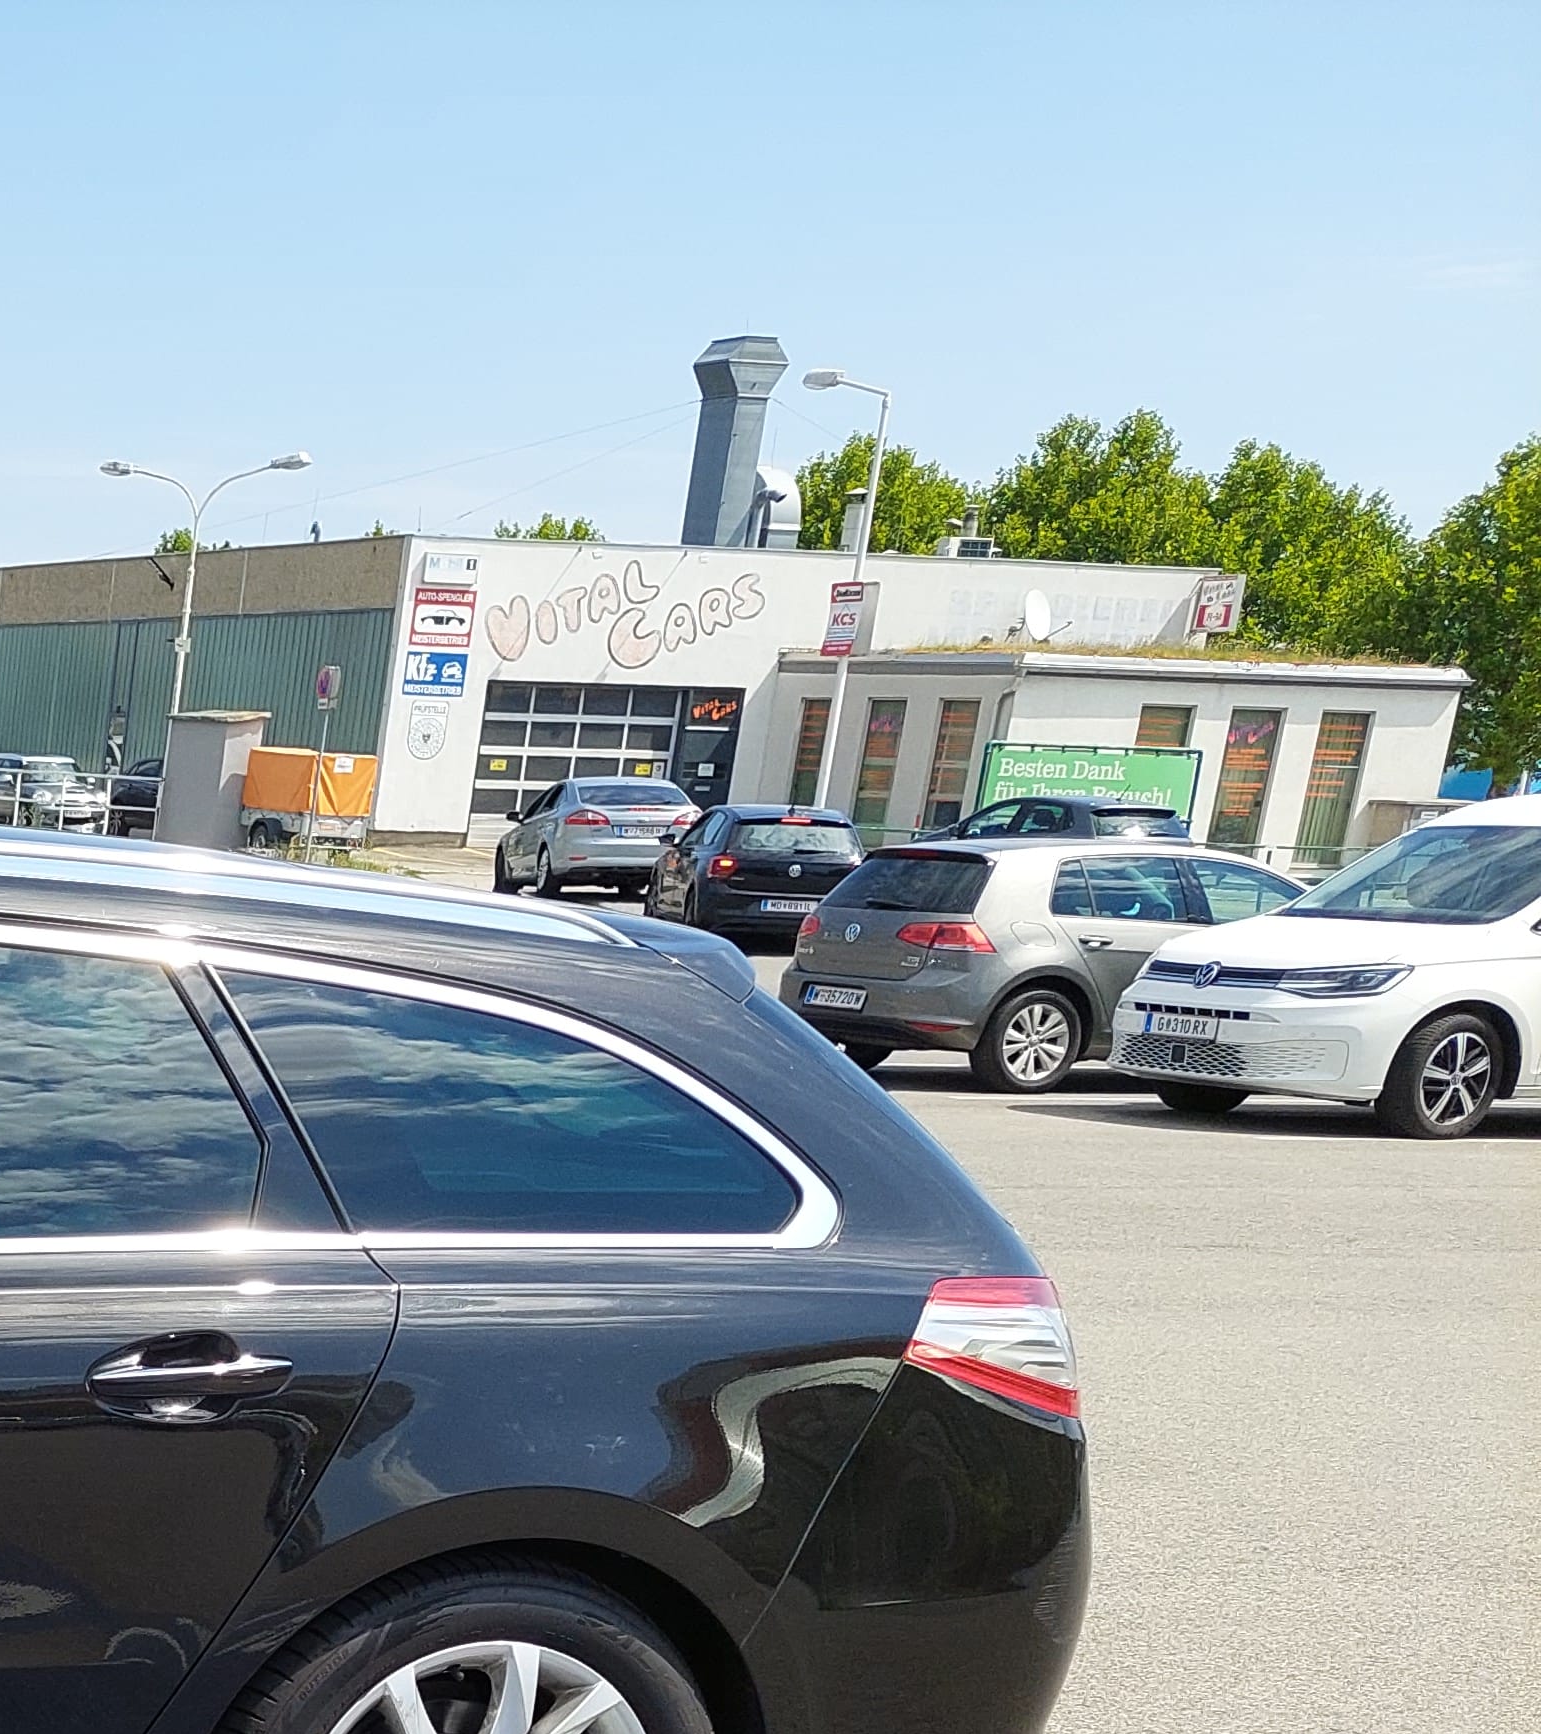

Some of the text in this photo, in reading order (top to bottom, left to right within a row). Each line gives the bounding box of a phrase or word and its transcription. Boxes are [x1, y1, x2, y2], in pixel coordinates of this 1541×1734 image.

[485, 560, 660, 662] VITAL
[607, 573, 766, 669] CARS
[831, 612, 857, 627] KCS
[405, 653, 438, 682] Kfz
[997, 757, 1126, 781] Besten Dank
[993, 780, 1026, 801] für
